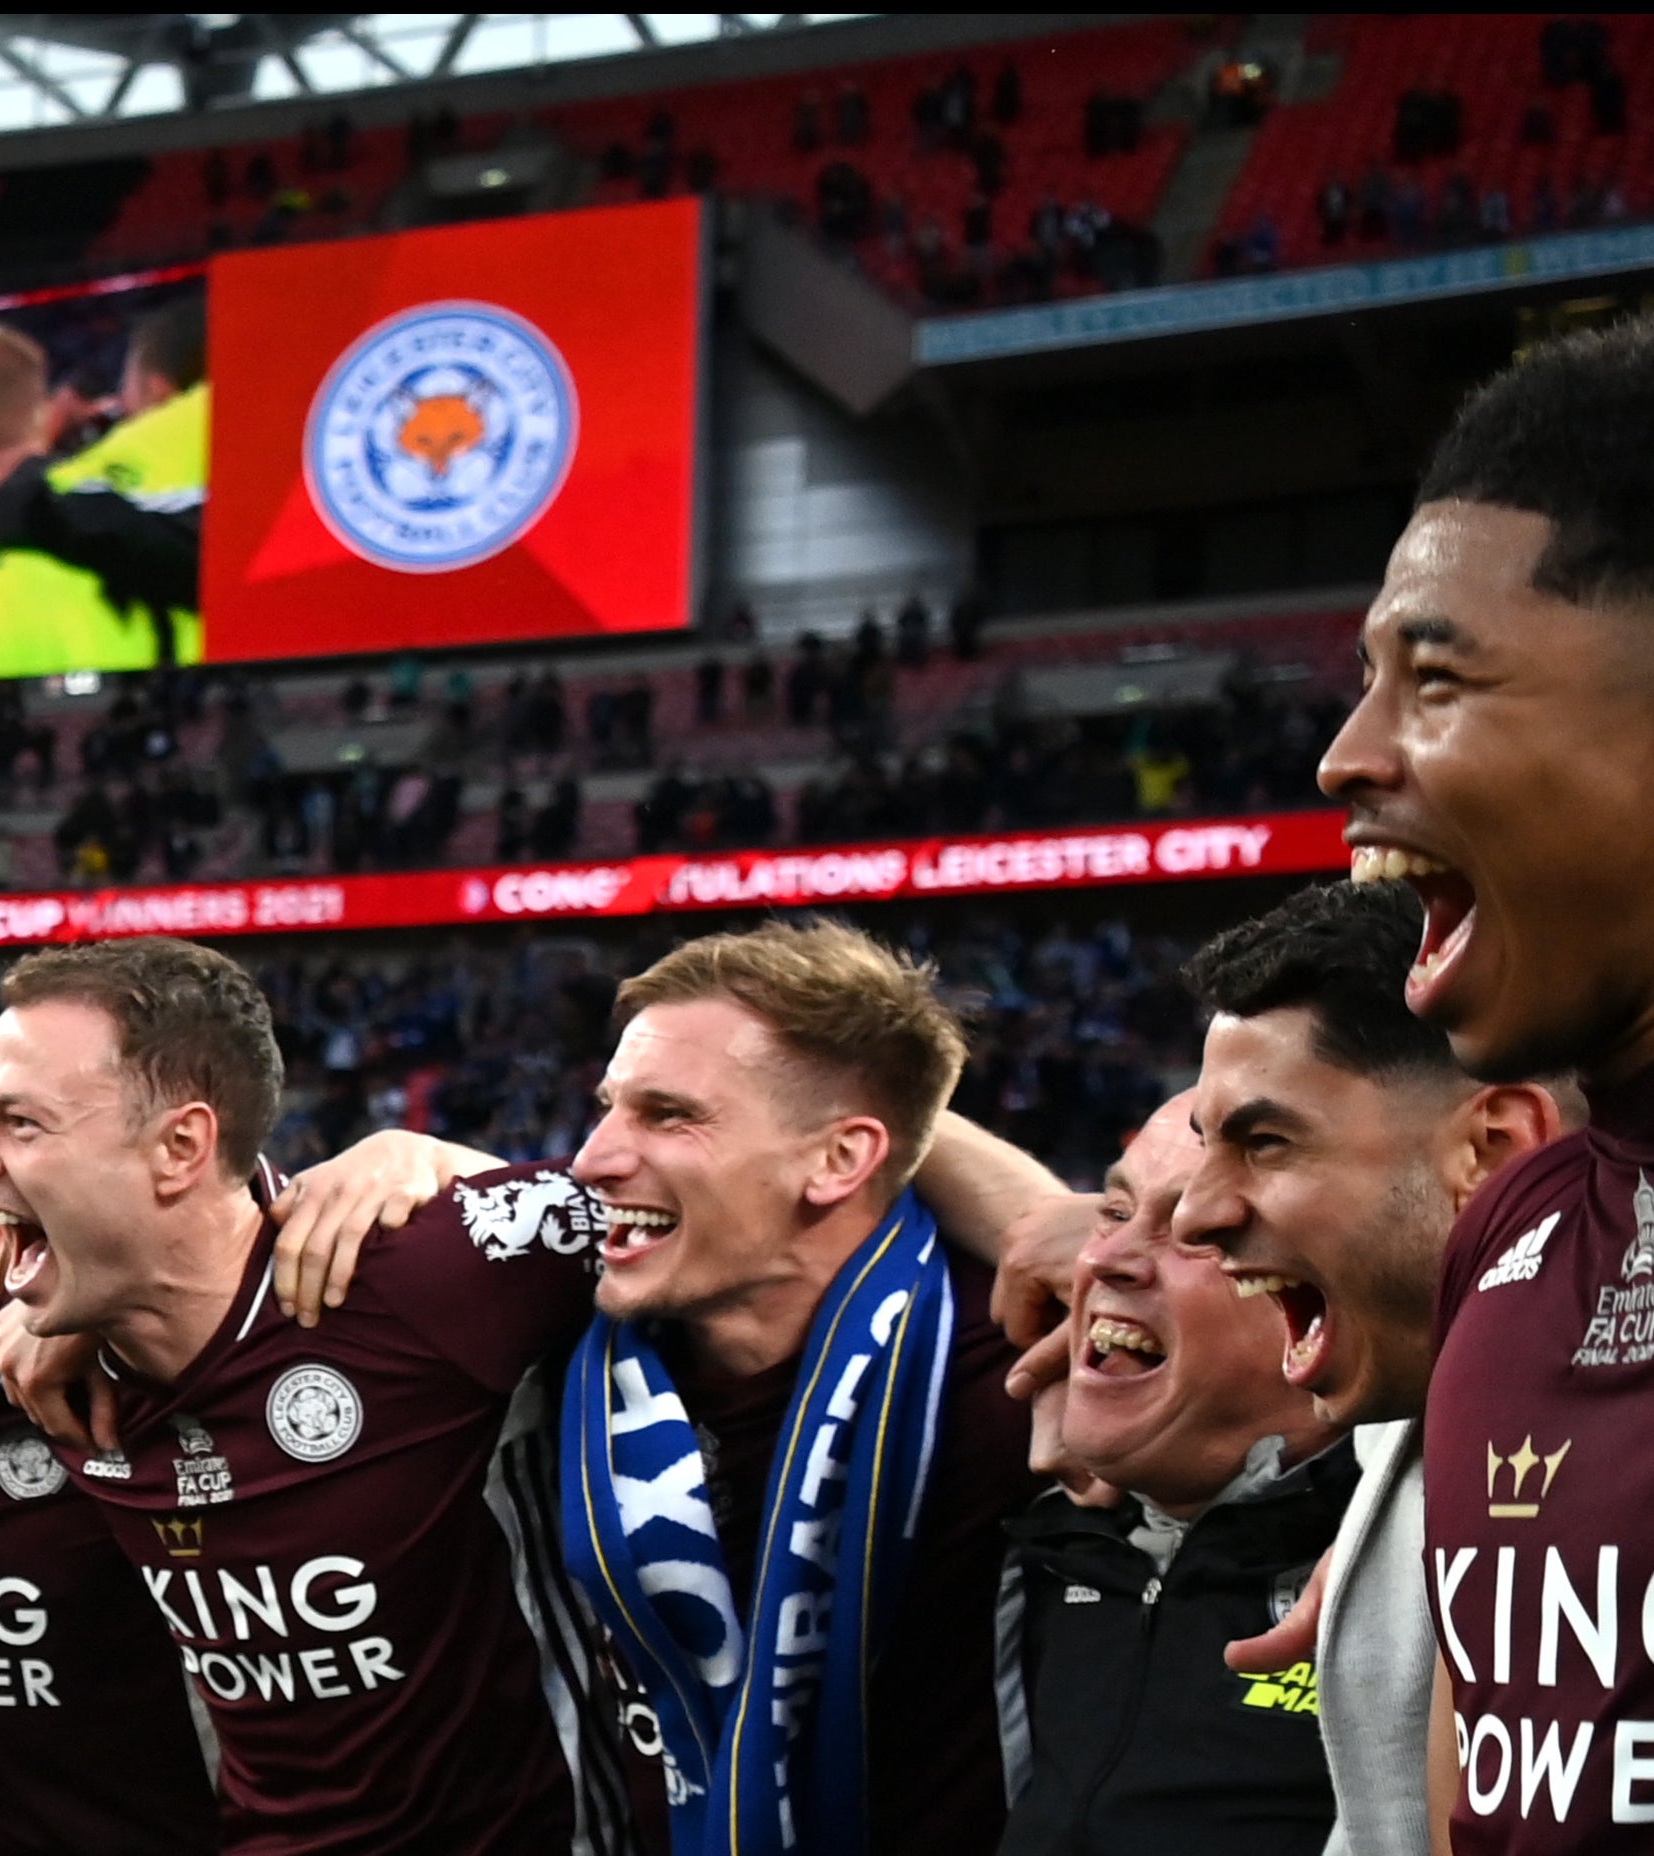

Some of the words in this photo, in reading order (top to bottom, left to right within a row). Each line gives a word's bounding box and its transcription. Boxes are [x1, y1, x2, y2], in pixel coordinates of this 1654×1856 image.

[911, 833, 1150, 889] LEICESTER
[1154, 825, 1271, 872] CITY
[566, 1195, 590, 1231] BIA
[1582, 1316, 1617, 1347] FA
[275, 1374, 322, 1420] LEICESTER
[323, 1377, 348, 1400] CITY
[280, 1426, 341, 1453] FOOTBALL
[338, 1405, 353, 1440] CLUB
[177, 1476, 198, 1495] FA
[198, 1471, 232, 1492] CUP
[140, 1555, 378, 1640] KING
[1435, 1544, 1654, 1690] KIN
